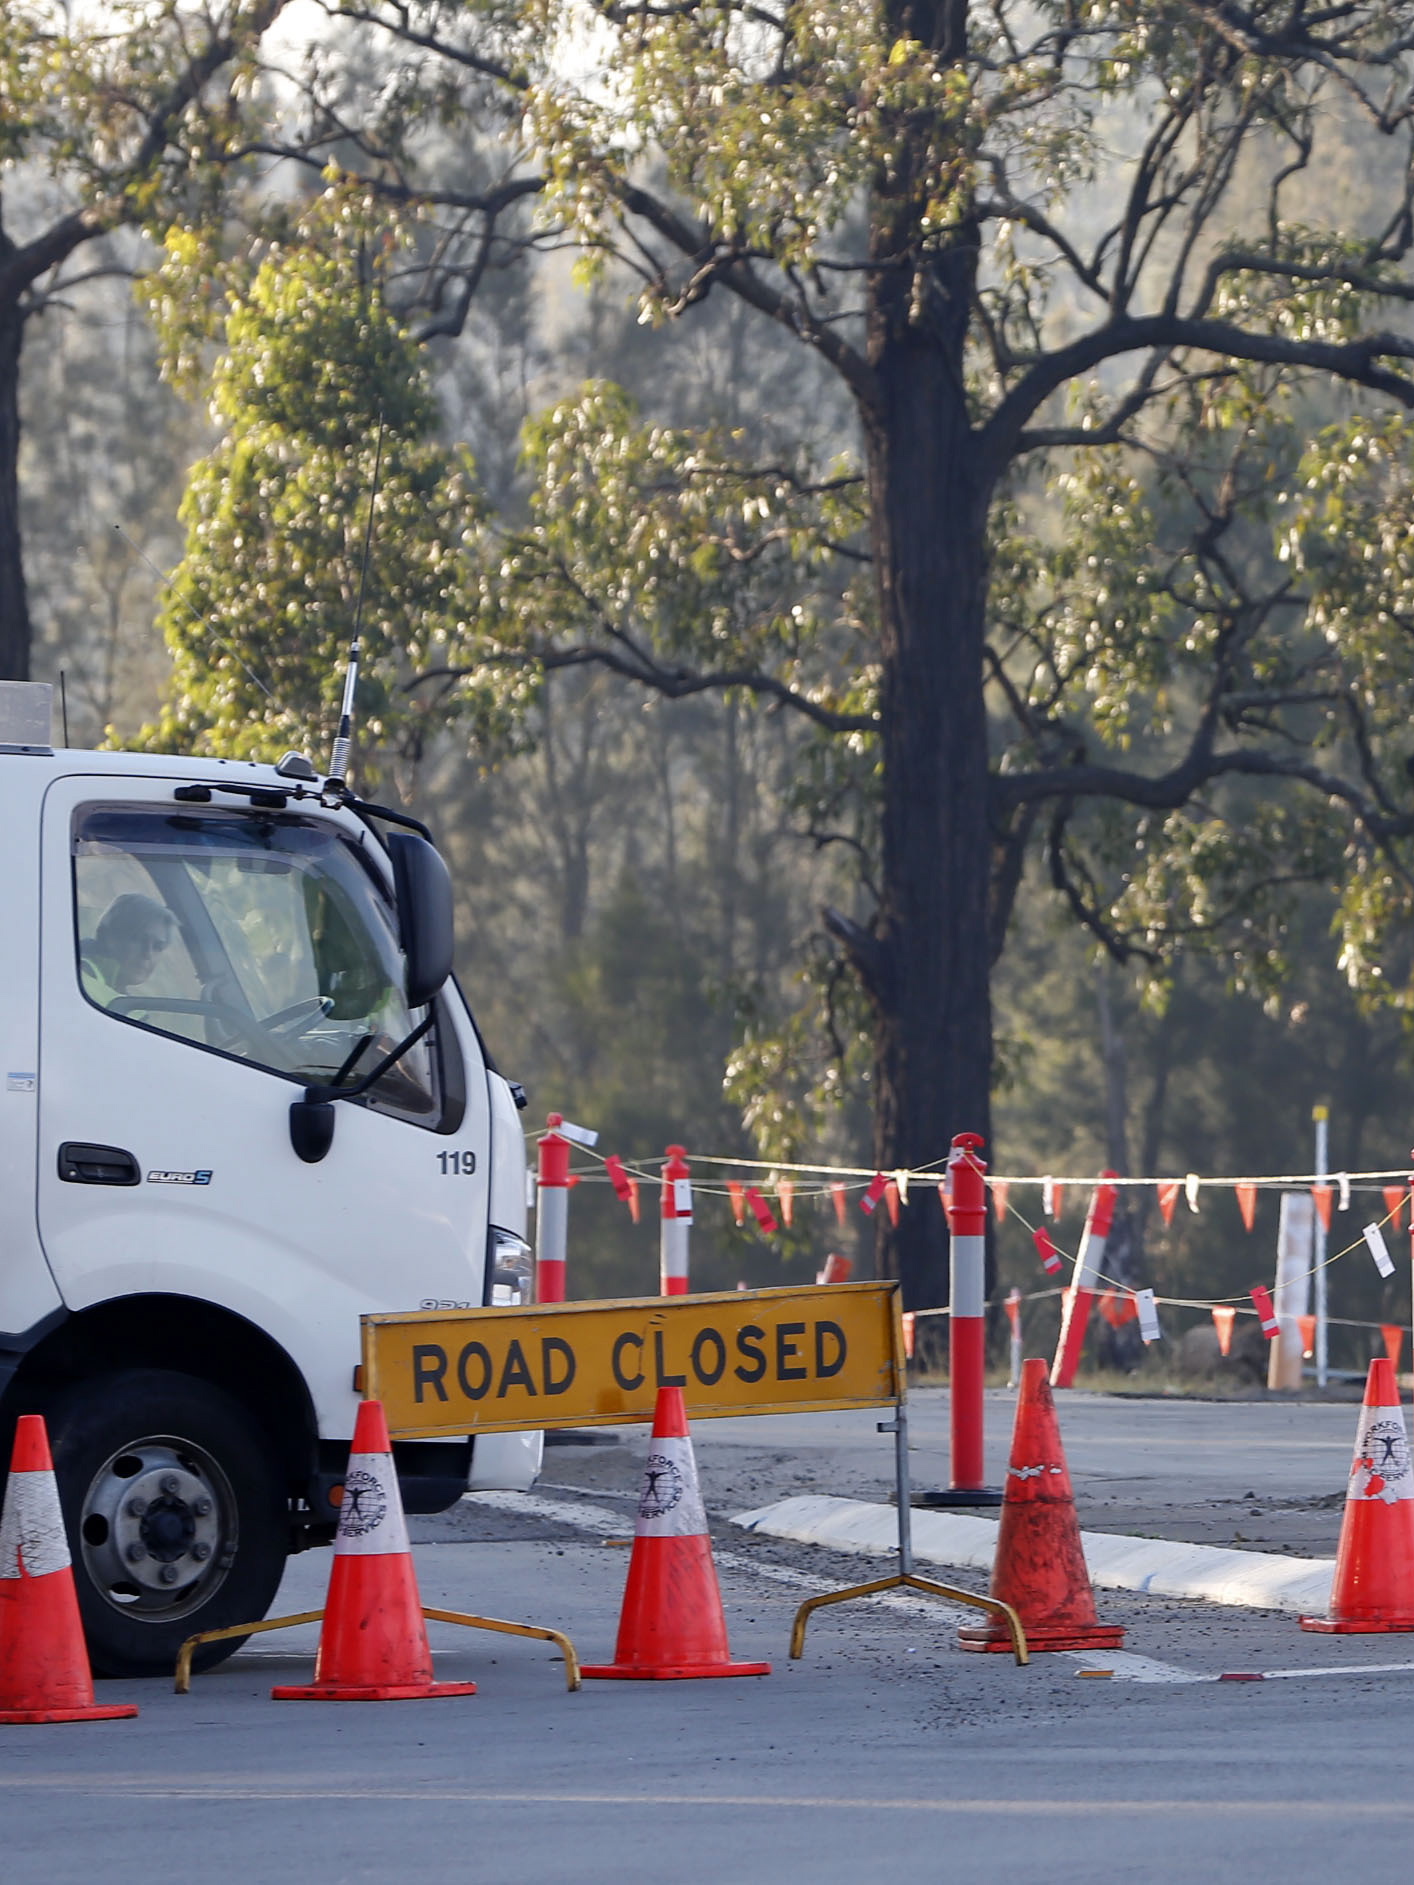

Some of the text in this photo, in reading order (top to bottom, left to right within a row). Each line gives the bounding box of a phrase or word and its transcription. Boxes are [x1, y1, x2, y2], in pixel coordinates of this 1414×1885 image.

[436, 1150, 476, 1175] 119
[412, 1320, 848, 1404] ROAD CLOSED
